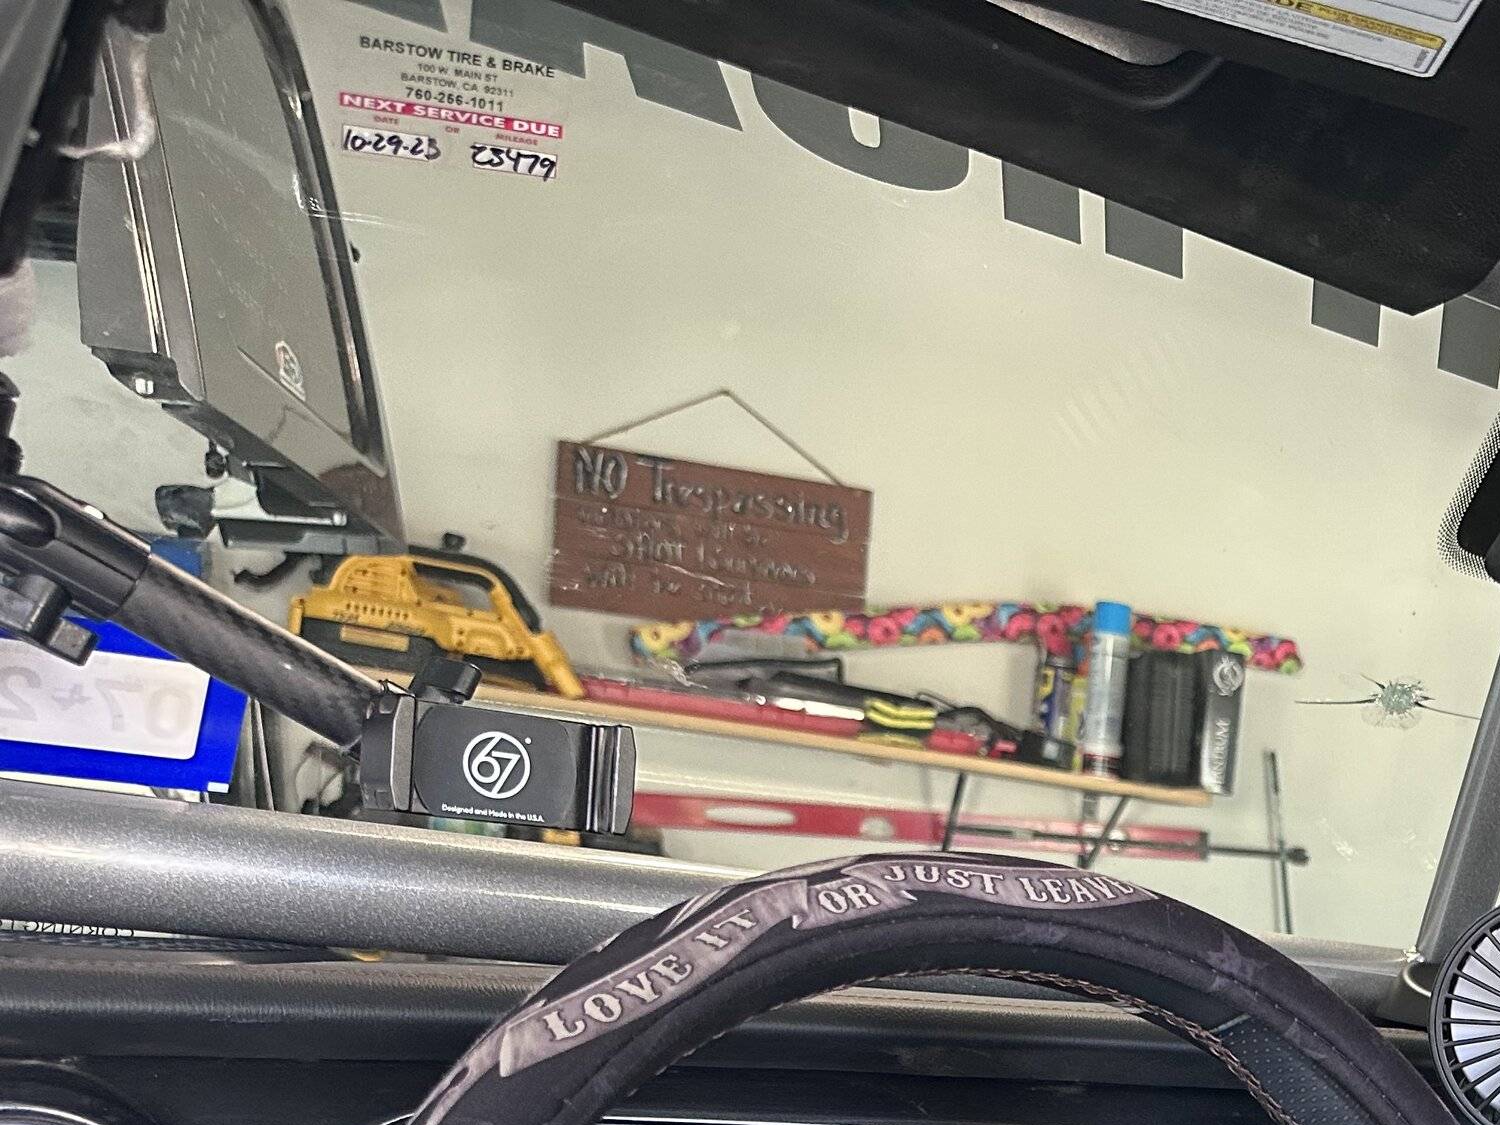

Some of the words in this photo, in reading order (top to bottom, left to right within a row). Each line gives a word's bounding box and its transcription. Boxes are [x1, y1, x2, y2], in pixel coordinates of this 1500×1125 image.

[359, 35, 443, 60] BARSTOW
[448, 51, 482, 67] TIRE
[486, 57, 497, 68] &
[502, 59, 555, 78] BRAKE
[454, 69, 482, 81] MAIN
[342, 94, 406, 113] NEXT
[413, 104, 505, 128] SERVICE
[513, 120, 561, 137] DUE
[373, 116, 399, 125] DATE
[445, 126, 460, 134] OR
[495, 133, 538, 146] MILEAGE
[574, 448, 628, 500] NO
[441, 803, 474, 815] Designed
[474, 808, 488, 816] and
[488, 809, 507, 818] Made
[515, 812, 527, 820] the
[542, 953, 693, 1041] LOVE
[695, 909, 758, 949] IT
[817, 883, 880, 914] OR
[883, 865, 1006, 895] JUST
